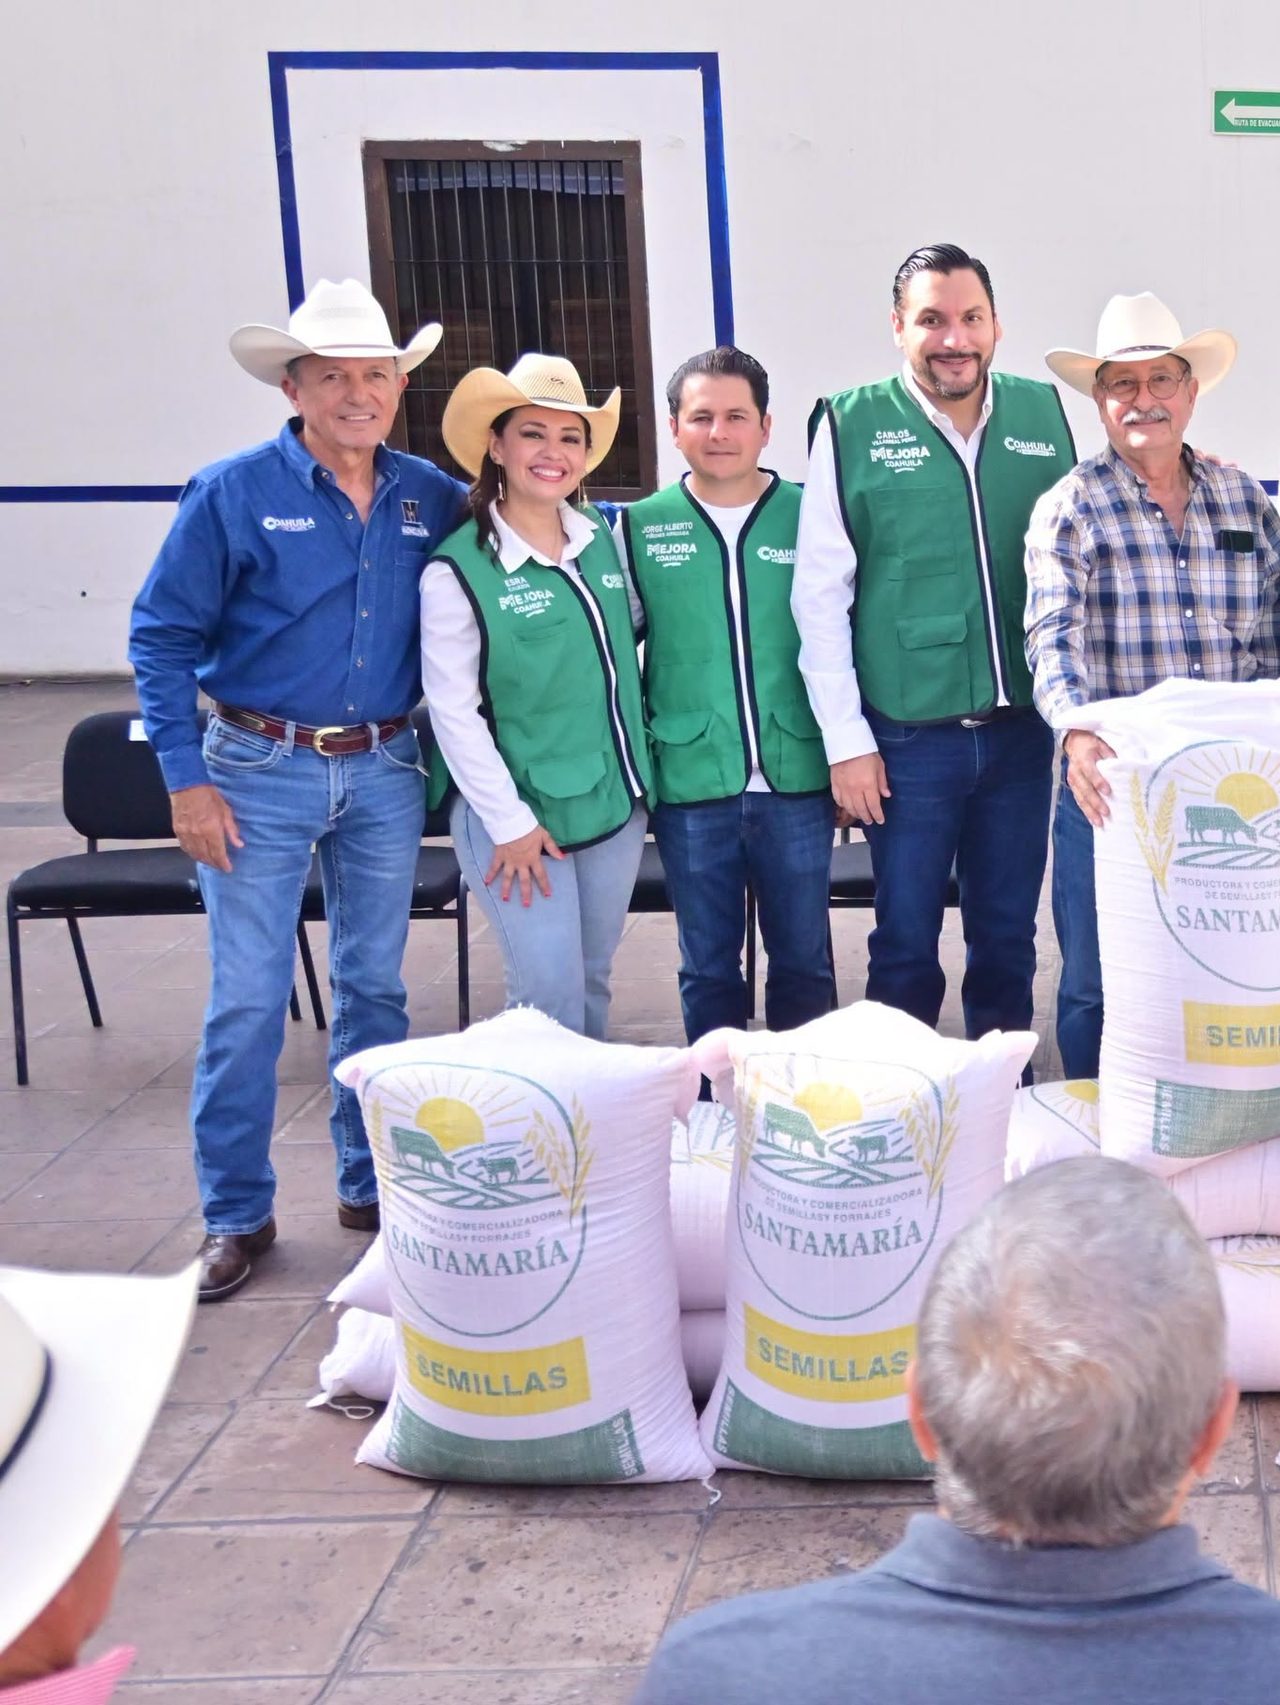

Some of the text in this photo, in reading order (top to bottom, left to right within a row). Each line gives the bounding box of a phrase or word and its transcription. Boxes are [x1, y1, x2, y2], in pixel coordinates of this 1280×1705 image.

[1250, 119, 1257, 127] DE
[876, 429, 910, 440] CARLOS
[1004, 436, 1056, 452] COAHUILA
[869, 446, 930, 463] MEJORA
[884, 458, 924, 468] COAHUILA
[262, 516, 315, 531] COAHUILA
[641, 524, 663, 534] JORGE
[664, 521, 694, 532] ALBERTO
[646, 543, 697, 557] MEJORA
[655, 554, 690, 562] COAHUILA
[498, 589, 555, 611] MEJORA
[1174, 877, 1242, 890] PRODUCTORA
[1204, 891, 1218, 900] DE
[810, 1187, 922, 1210] COMERCIALIZADORA
[447, 1209, 564, 1232] COMERCIALIZADORA
[833, 1208, 892, 1223] FORRAJES
[471, 1229, 531, 1243] FORRAJES
[744, 1203, 923, 1258] SANTAMARÍA
[391, 1224, 569, 1277] SANTAMARÍA
[757, 1336, 909, 1383] SEMILLAS
[415, 1353, 568, 1397] SEMILLAS
[717, 1385, 736, 1454] SEMILLAS
[611, 1416, 638, 1478] SEMILLAS
